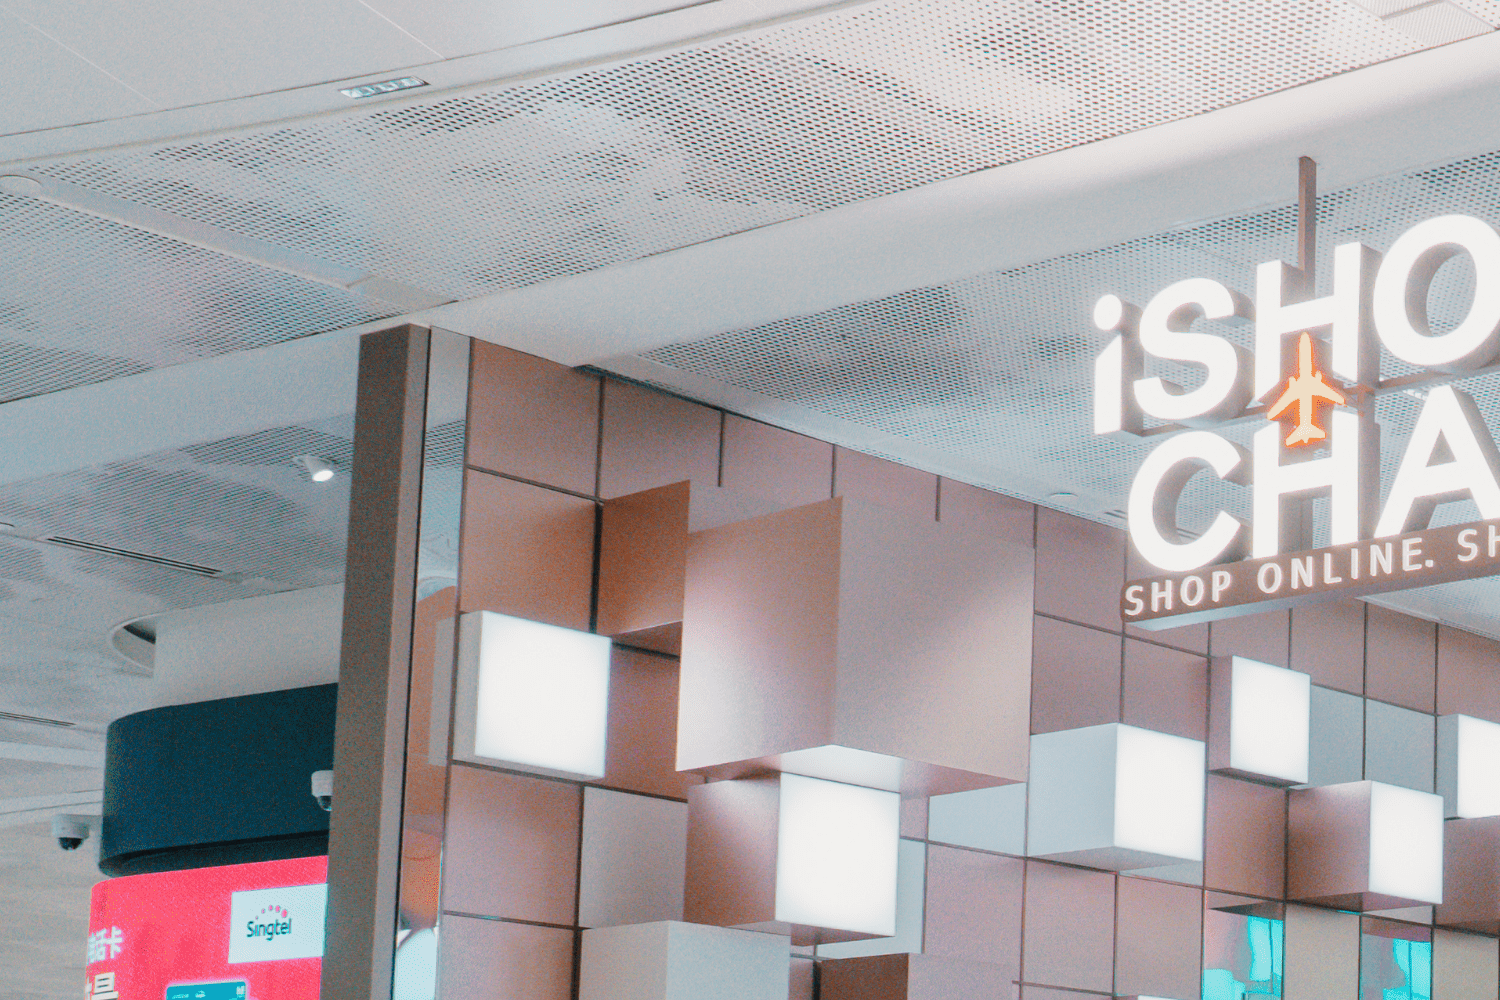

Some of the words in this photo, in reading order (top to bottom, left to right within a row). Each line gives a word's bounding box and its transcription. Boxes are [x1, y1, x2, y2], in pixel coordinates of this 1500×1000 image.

[1125, 574, 1232, 617] SHOP
[1257, 540, 1435, 594] ONLINE.
[246, 918, 292, 941] Singtel
